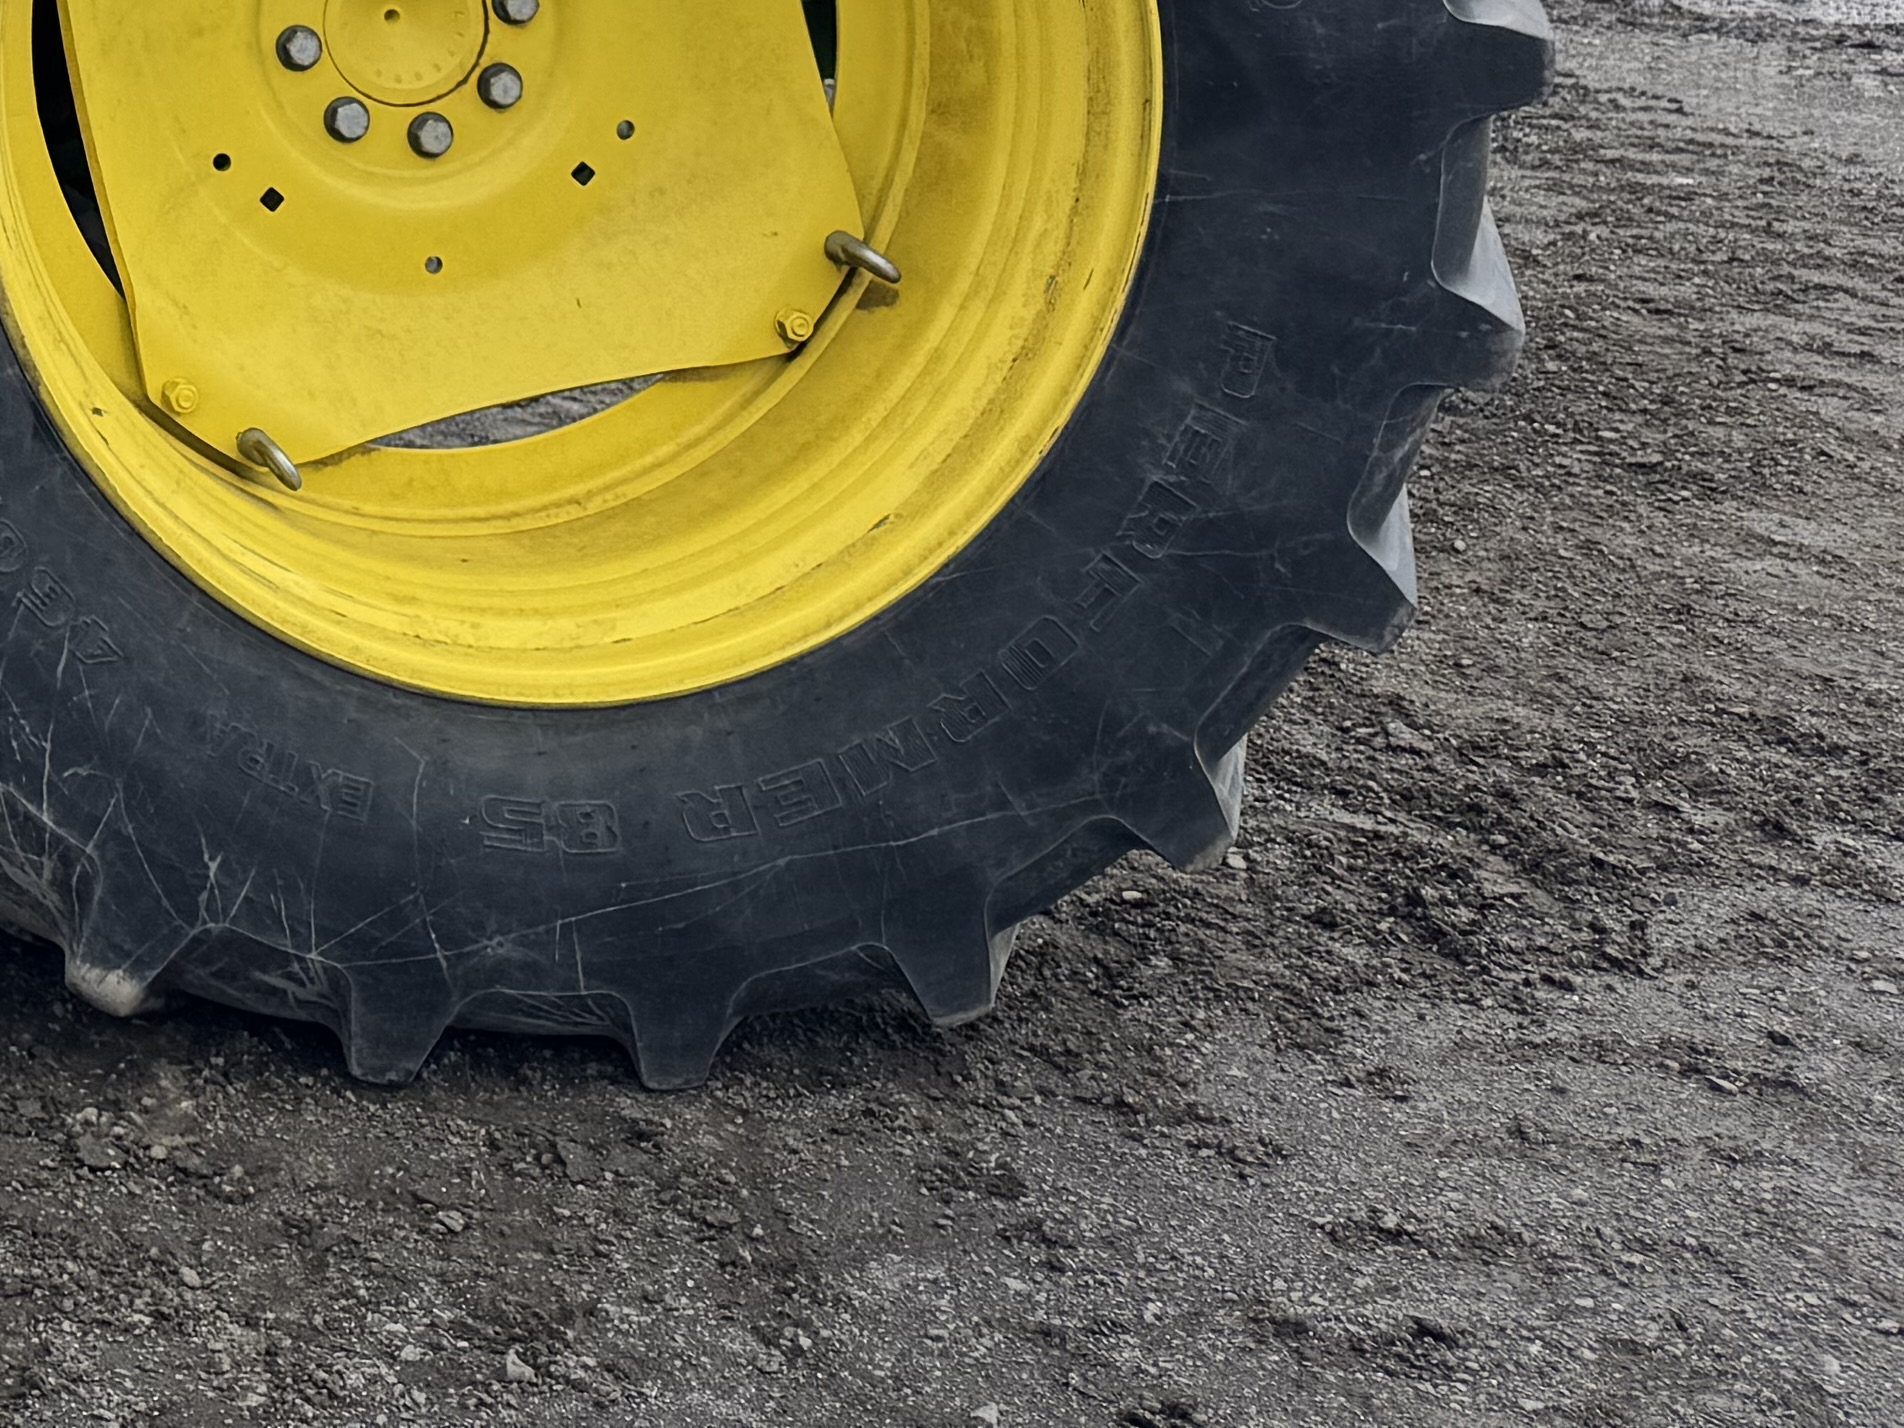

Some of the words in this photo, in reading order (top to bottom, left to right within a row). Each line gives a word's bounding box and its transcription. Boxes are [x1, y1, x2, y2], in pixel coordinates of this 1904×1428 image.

[677, 322, 1280, 845] PERFORMER
[196, 708, 378, 824] EXTRA
[478, 794, 621, 854] 85
